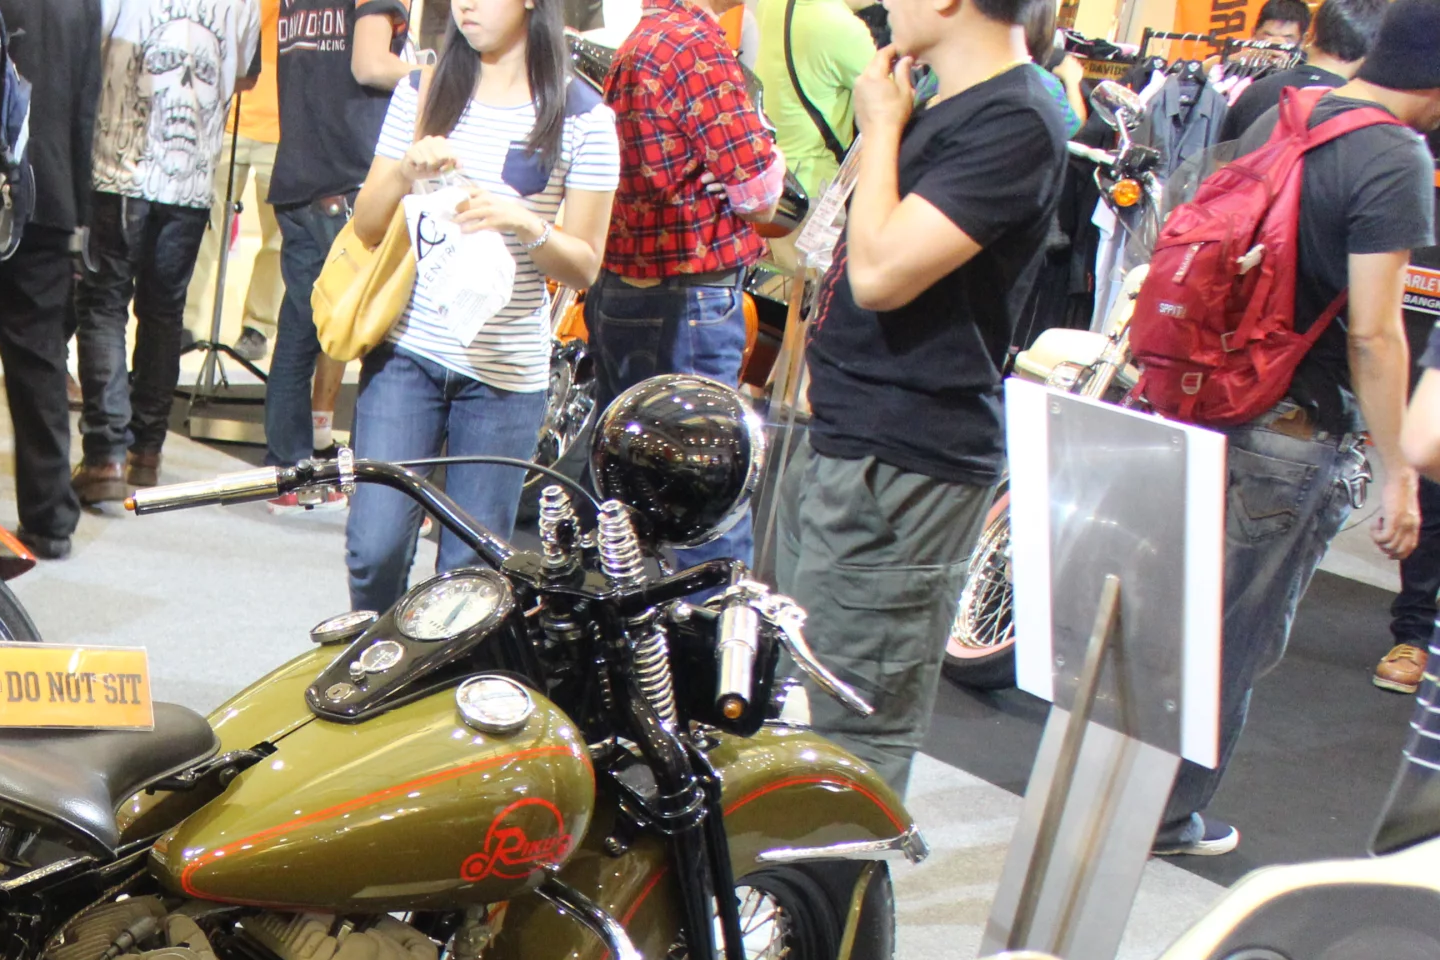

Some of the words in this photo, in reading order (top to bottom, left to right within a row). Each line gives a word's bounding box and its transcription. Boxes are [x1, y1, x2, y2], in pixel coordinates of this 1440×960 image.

[5, 670, 41, 703] DO
[46, 671, 97, 704] NOT
[103, 672, 142, 705] SIT
